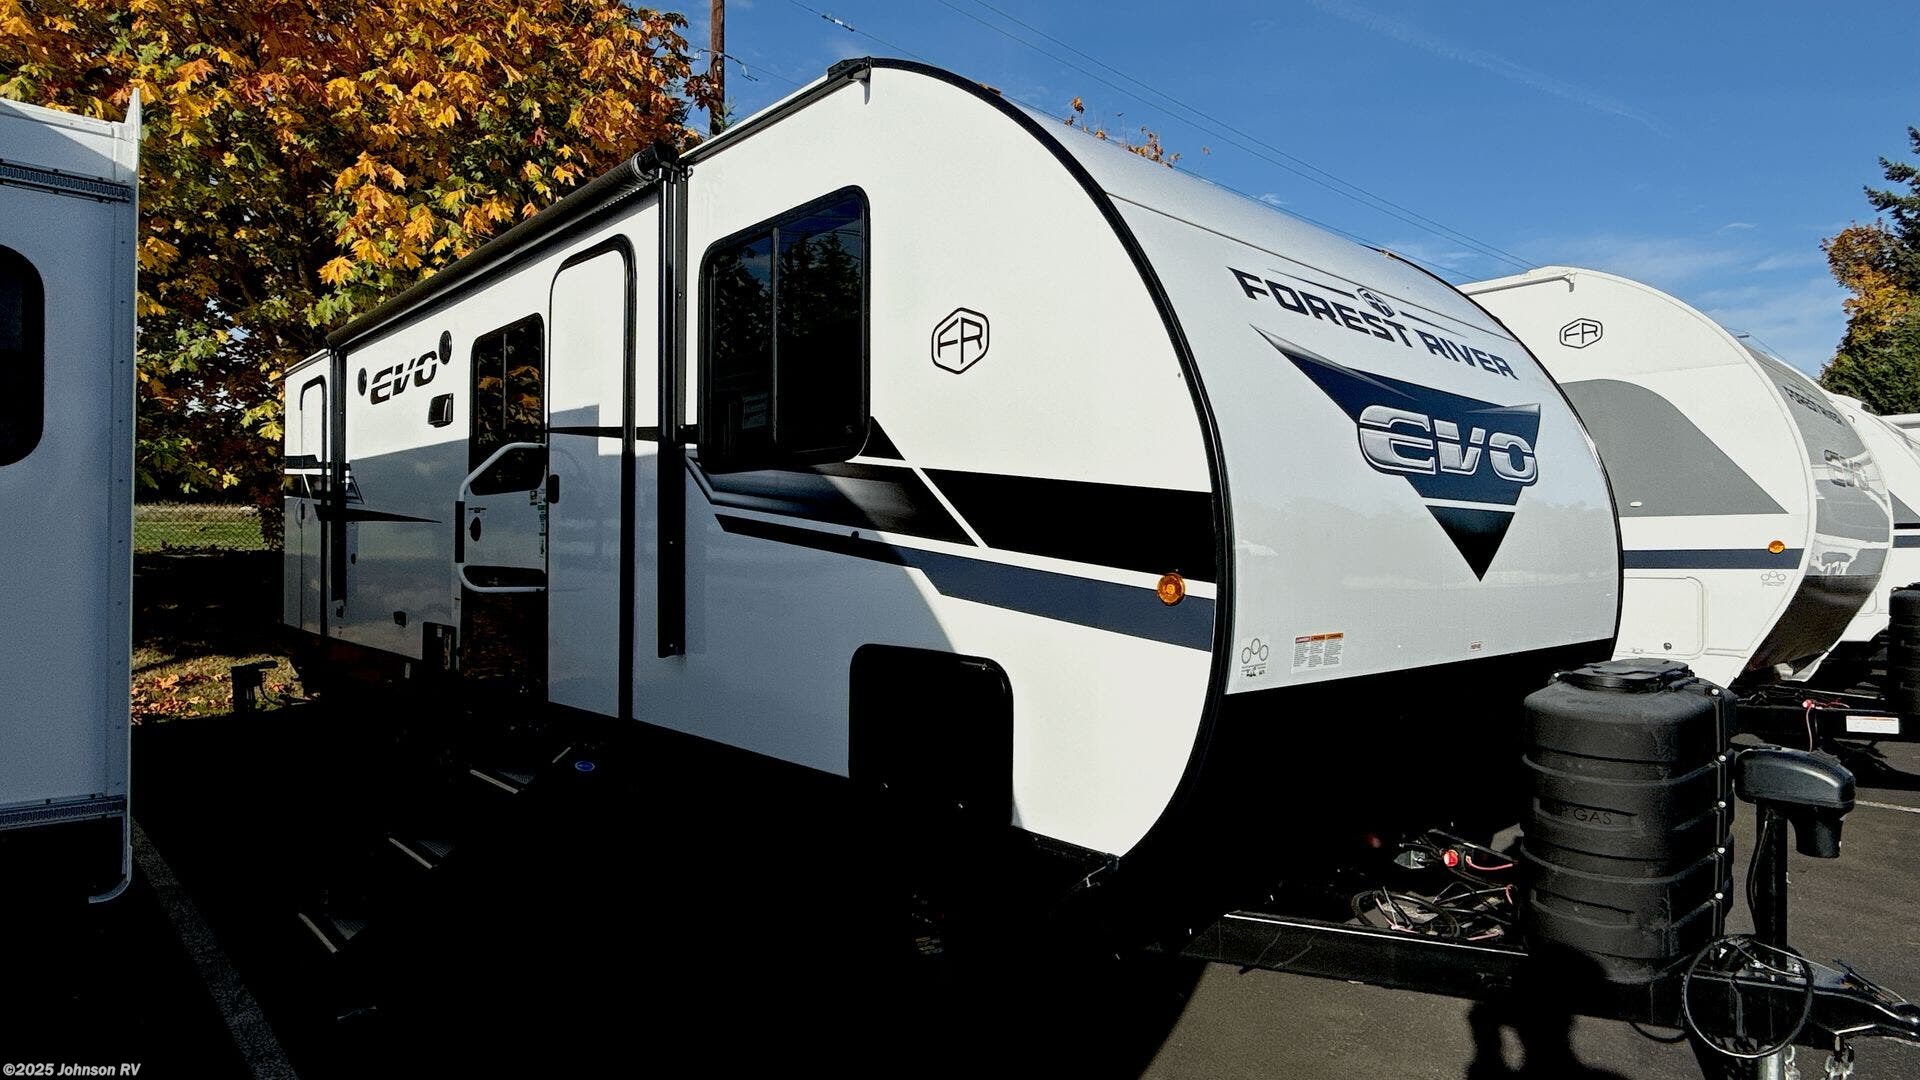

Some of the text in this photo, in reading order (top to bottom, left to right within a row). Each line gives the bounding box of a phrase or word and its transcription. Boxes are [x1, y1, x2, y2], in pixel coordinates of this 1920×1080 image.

[1226, 266, 1520, 381] FOREST RIVER
[369, 350, 438, 405] EVO
[1358, 404, 1538, 484] EVO
[1573, 807, 1612, 826] GAS
